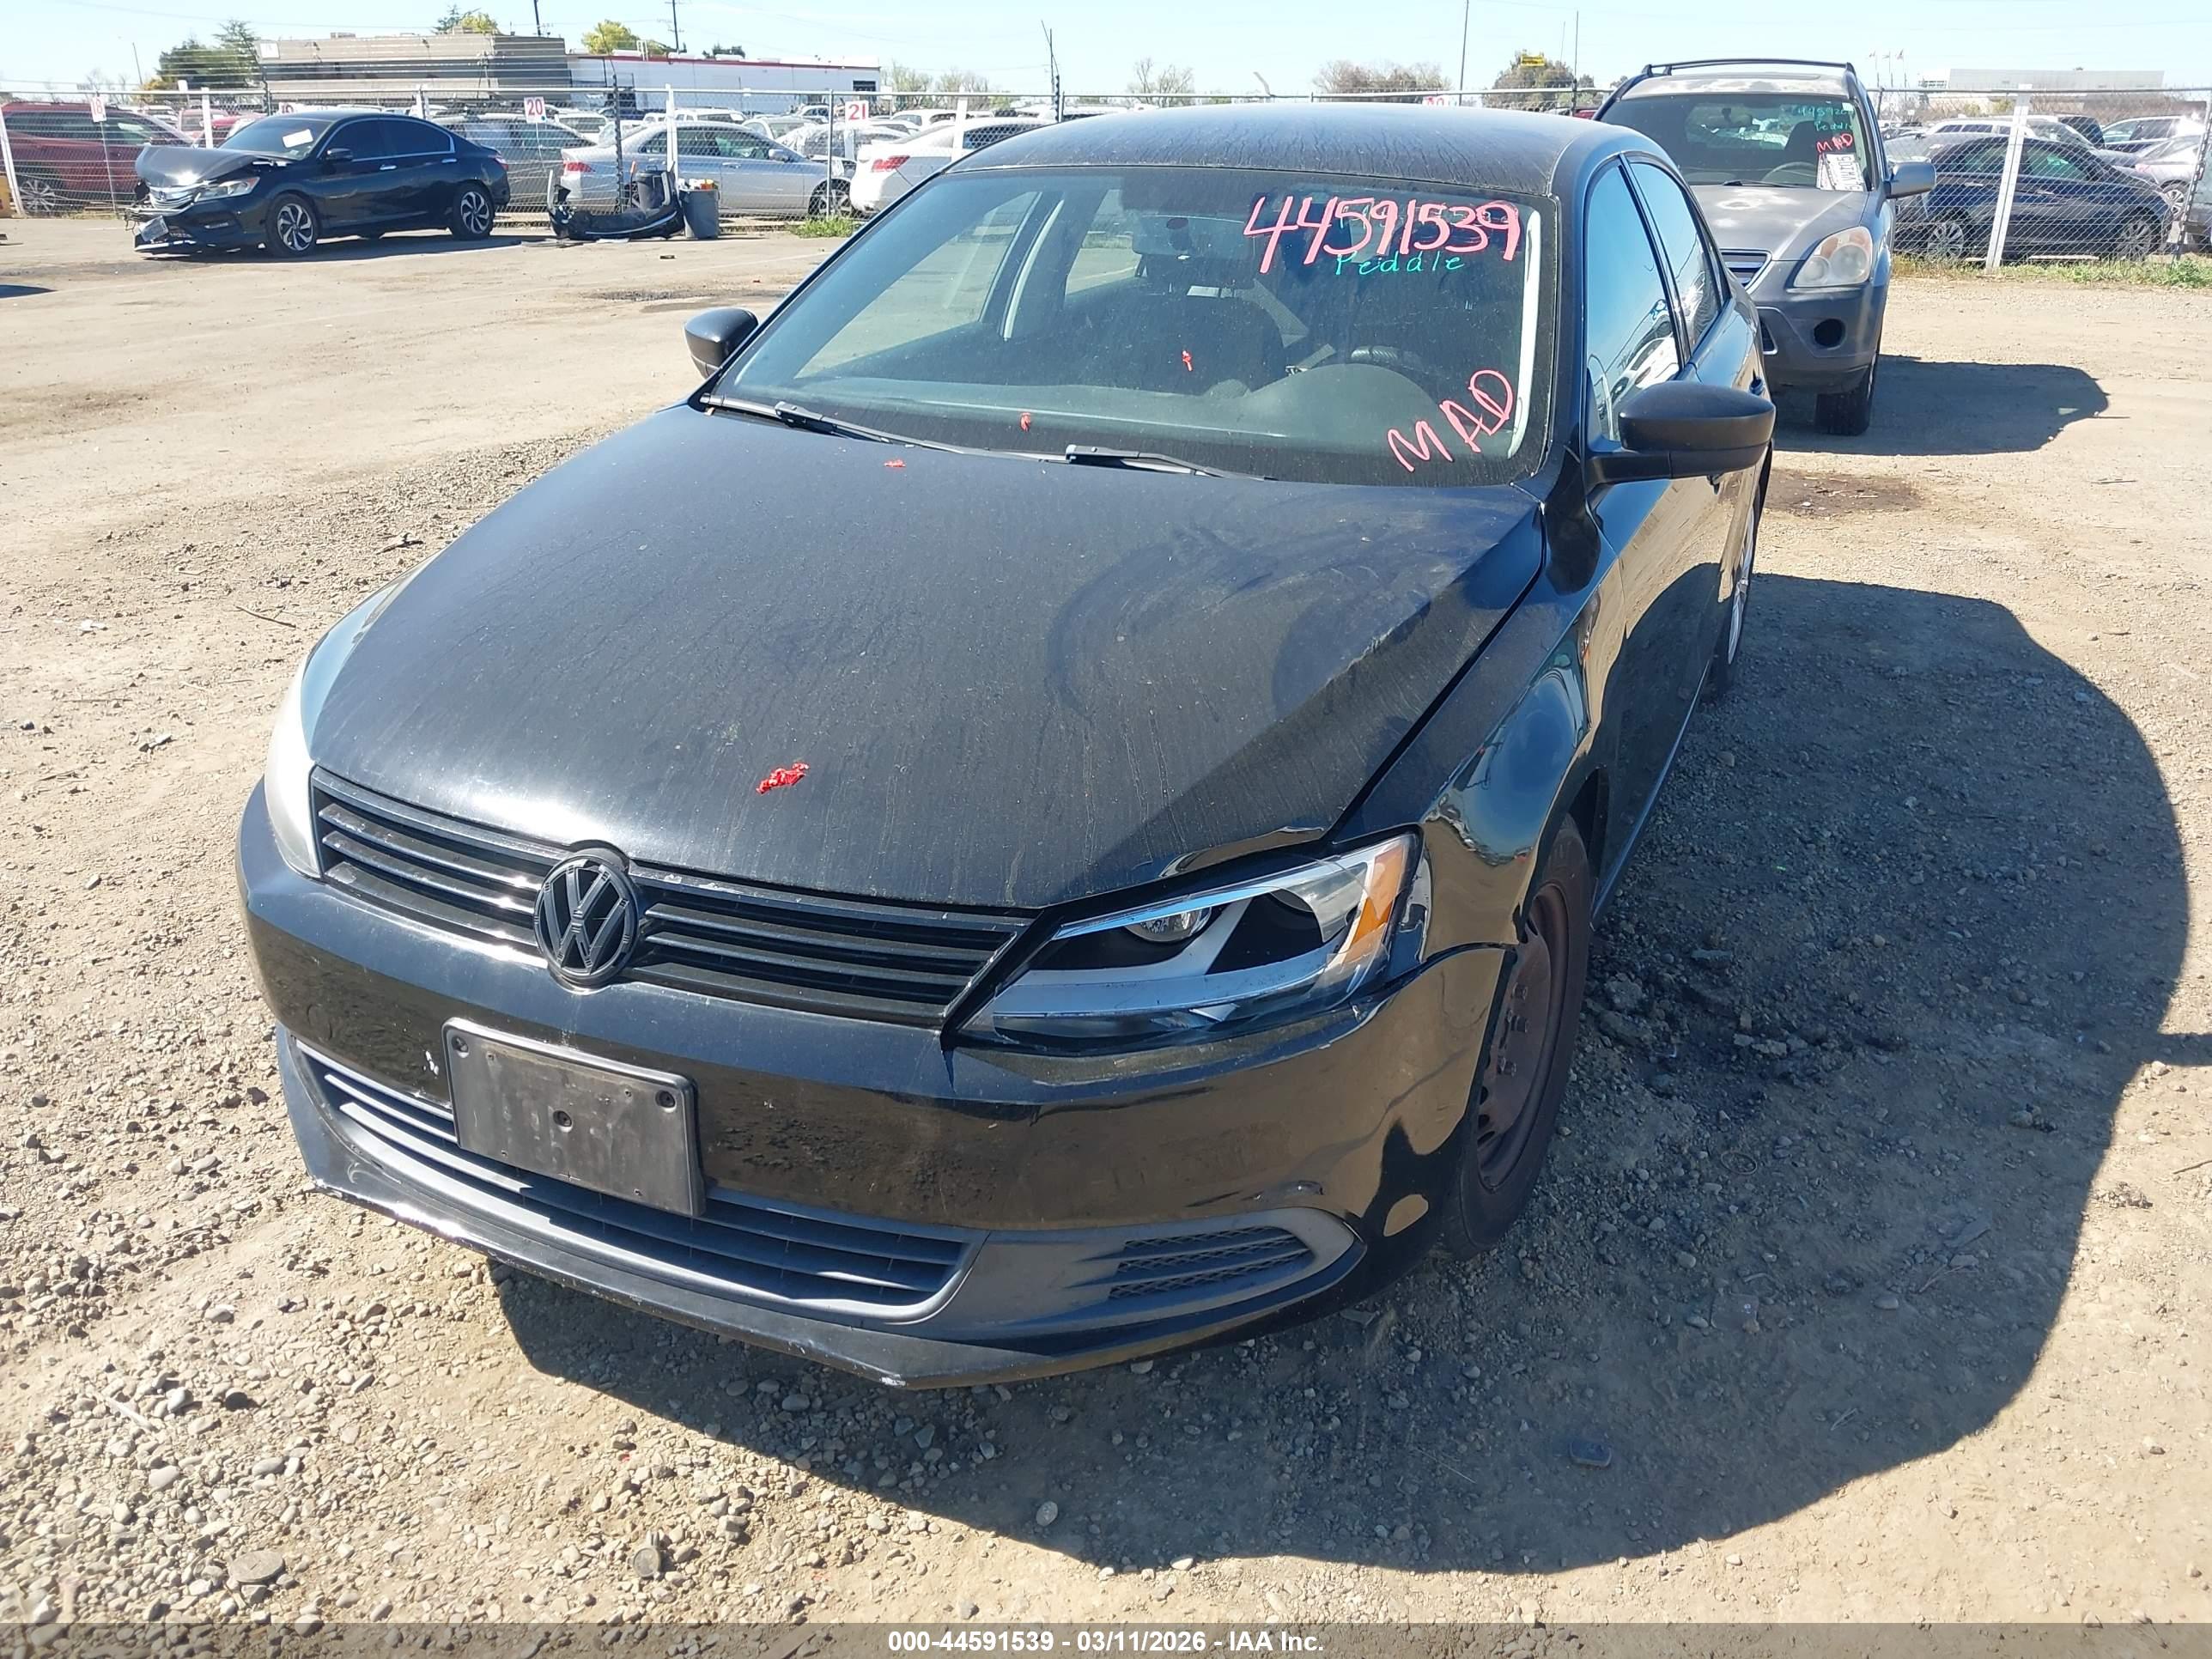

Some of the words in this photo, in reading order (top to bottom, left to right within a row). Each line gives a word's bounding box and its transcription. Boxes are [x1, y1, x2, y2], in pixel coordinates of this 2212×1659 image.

[527, 99, 544, 116] 20
[848, 103, 866, 120] 21
[1243, 195, 1521, 274] 44591539
[1334, 251, 1465, 276] Peddle
[1387, 369, 1514, 472] MAD
